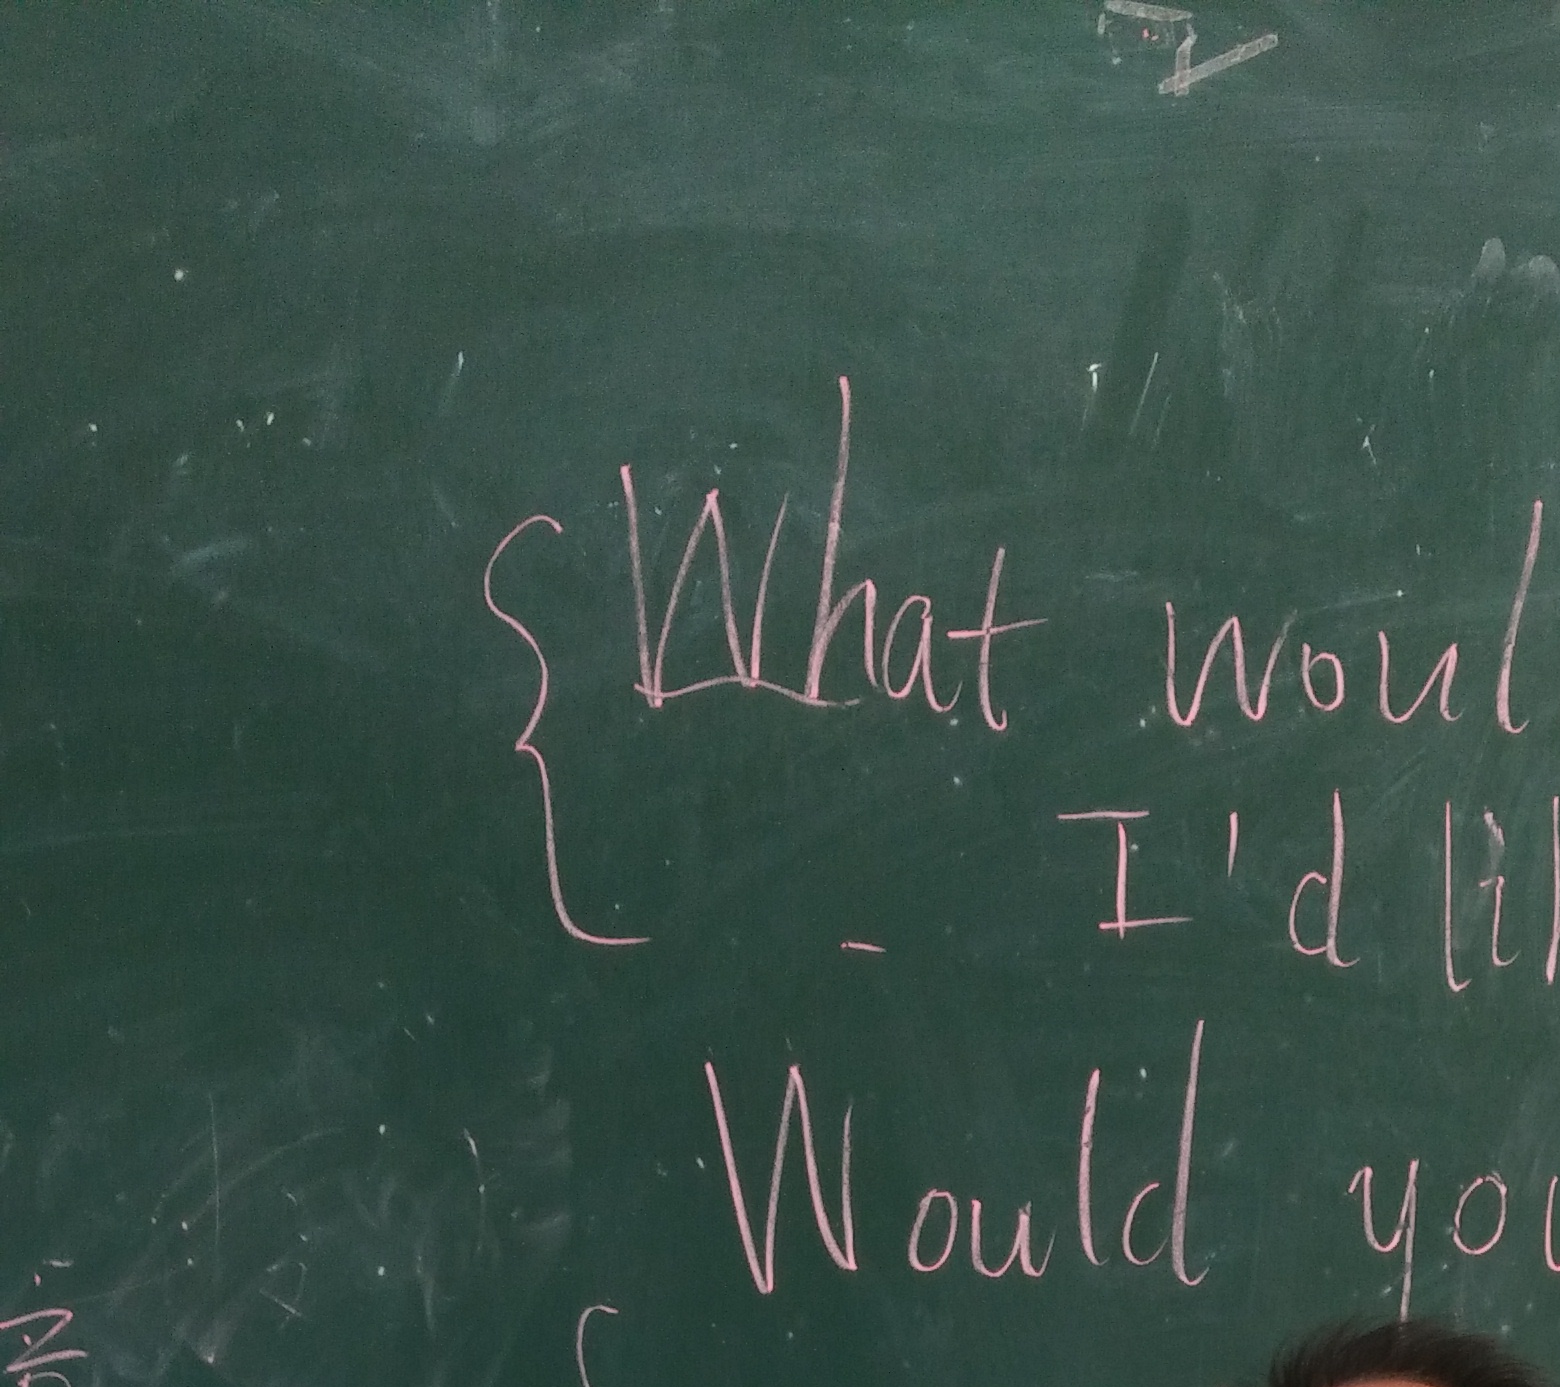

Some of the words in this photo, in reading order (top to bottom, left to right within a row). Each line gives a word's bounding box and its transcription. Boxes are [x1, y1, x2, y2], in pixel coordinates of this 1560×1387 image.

[621, 374, 1050, 732] What
[1054, 788, 1362, 968] I'd
[703, 1018, 1214, 1295] Would
